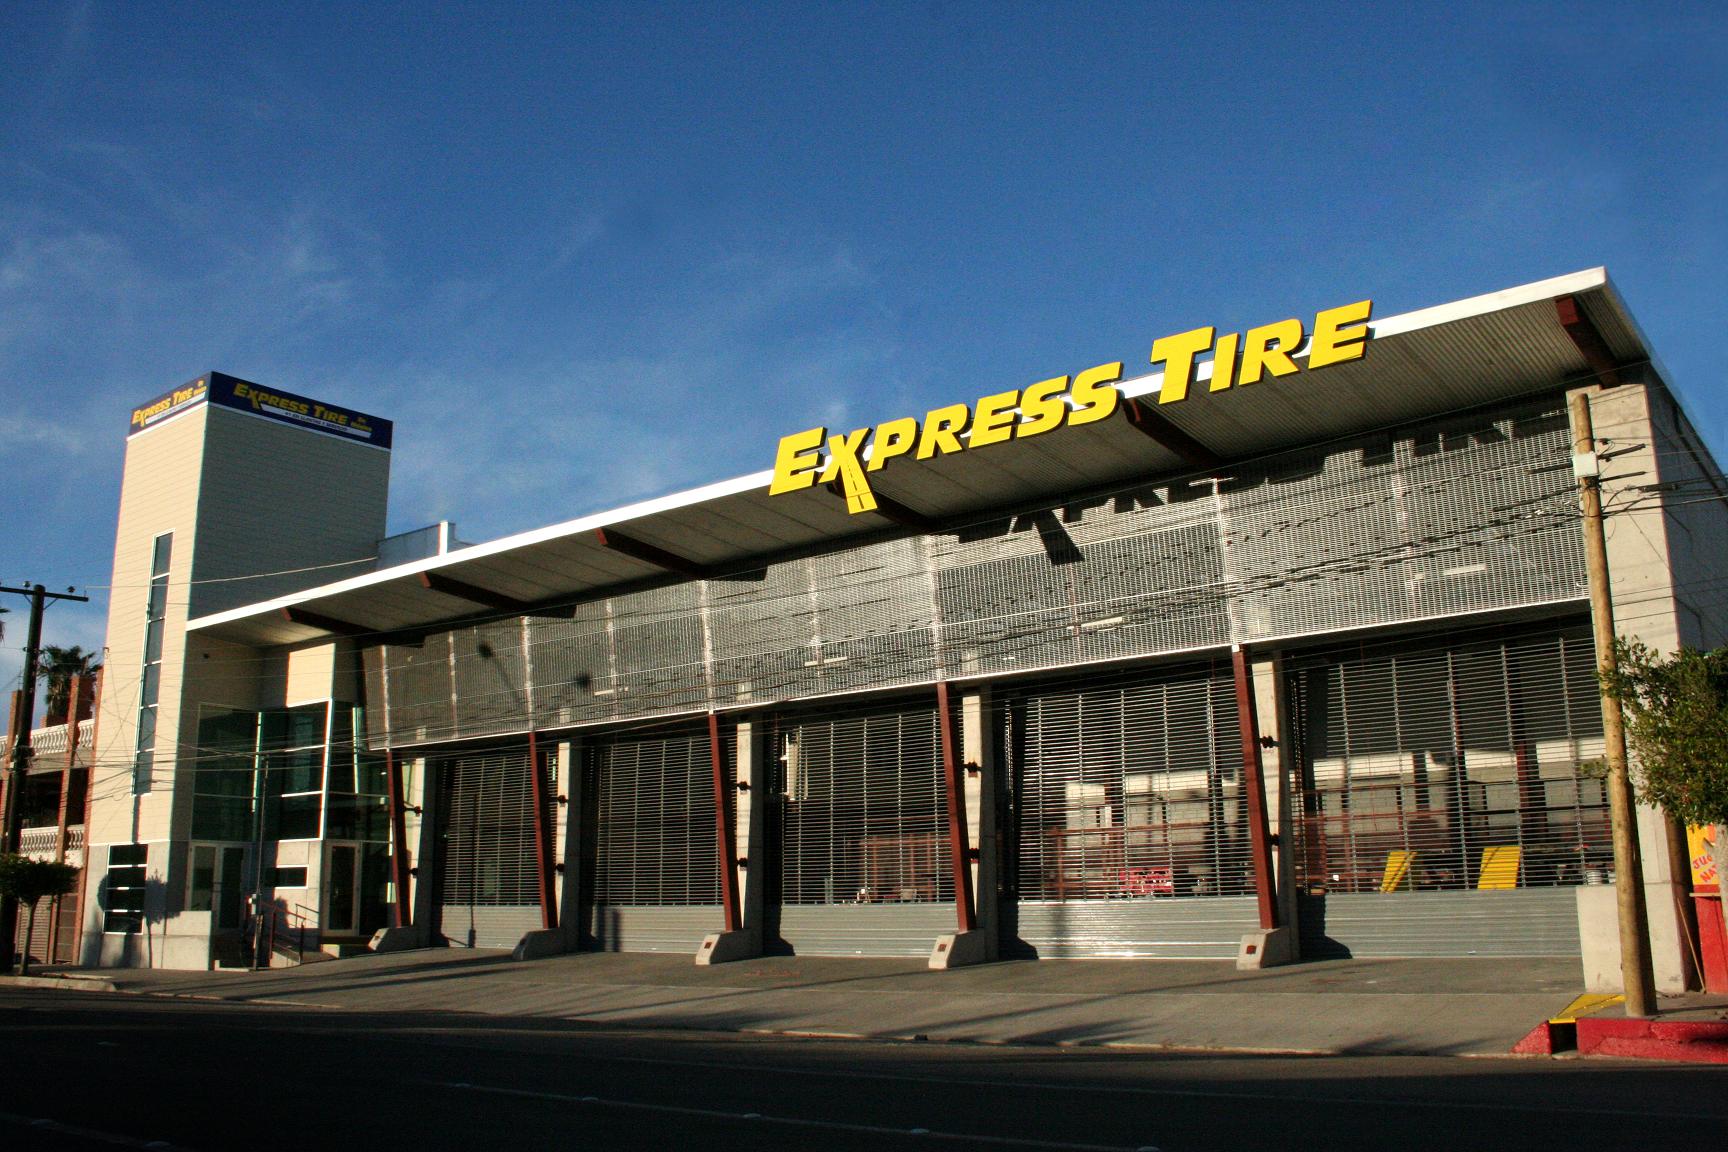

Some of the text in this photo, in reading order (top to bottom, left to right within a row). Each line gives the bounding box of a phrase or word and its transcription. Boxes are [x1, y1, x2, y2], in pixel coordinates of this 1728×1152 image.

[233, 383, 309, 415] EXPRESS
[313, 404, 349, 425] TIRE
[768, 299, 1374, 515] EXPRESS TIRE
